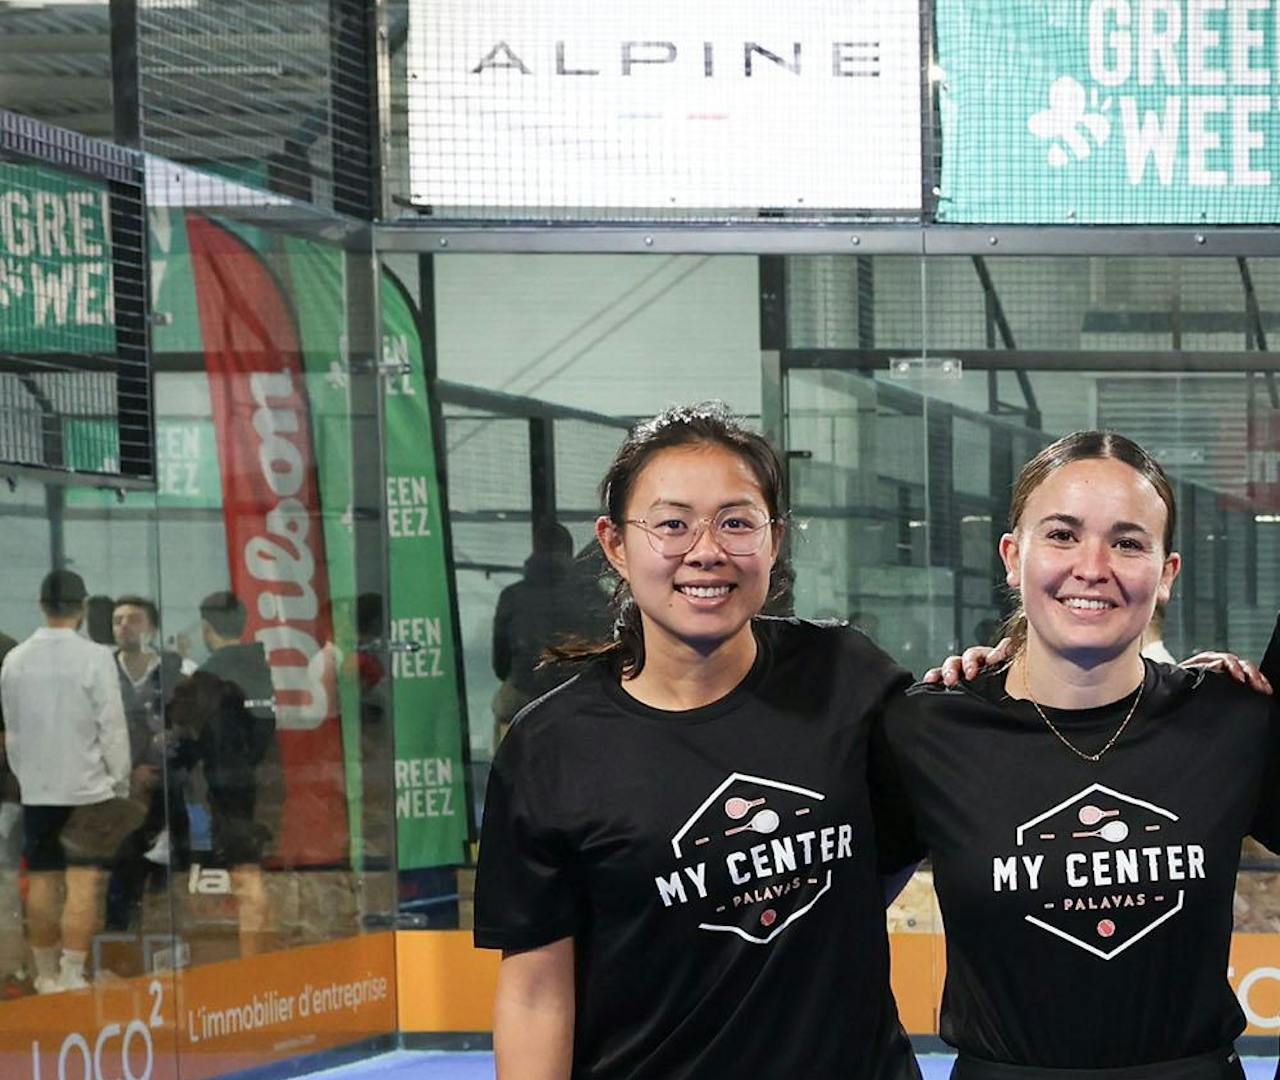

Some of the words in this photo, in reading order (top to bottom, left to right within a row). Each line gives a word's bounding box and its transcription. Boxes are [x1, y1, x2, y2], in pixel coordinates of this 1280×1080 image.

[471, 40, 881, 77] ALPINE
[1, 190, 112, 258] GRE
[31, 262, 115, 327] WE
[655, 864, 708, 906] MY
[727, 825, 853, 885] CENTER
[734, 878, 800, 907] PALAVAS
[993, 855, 1042, 891] MY
[1066, 844, 1205, 887] CENTER
[1064, 893, 1146, 910] PALAVAS
[188, 992, 294, 1043] L'immobilier
[298, 973, 388, 1018] d'entreprise
